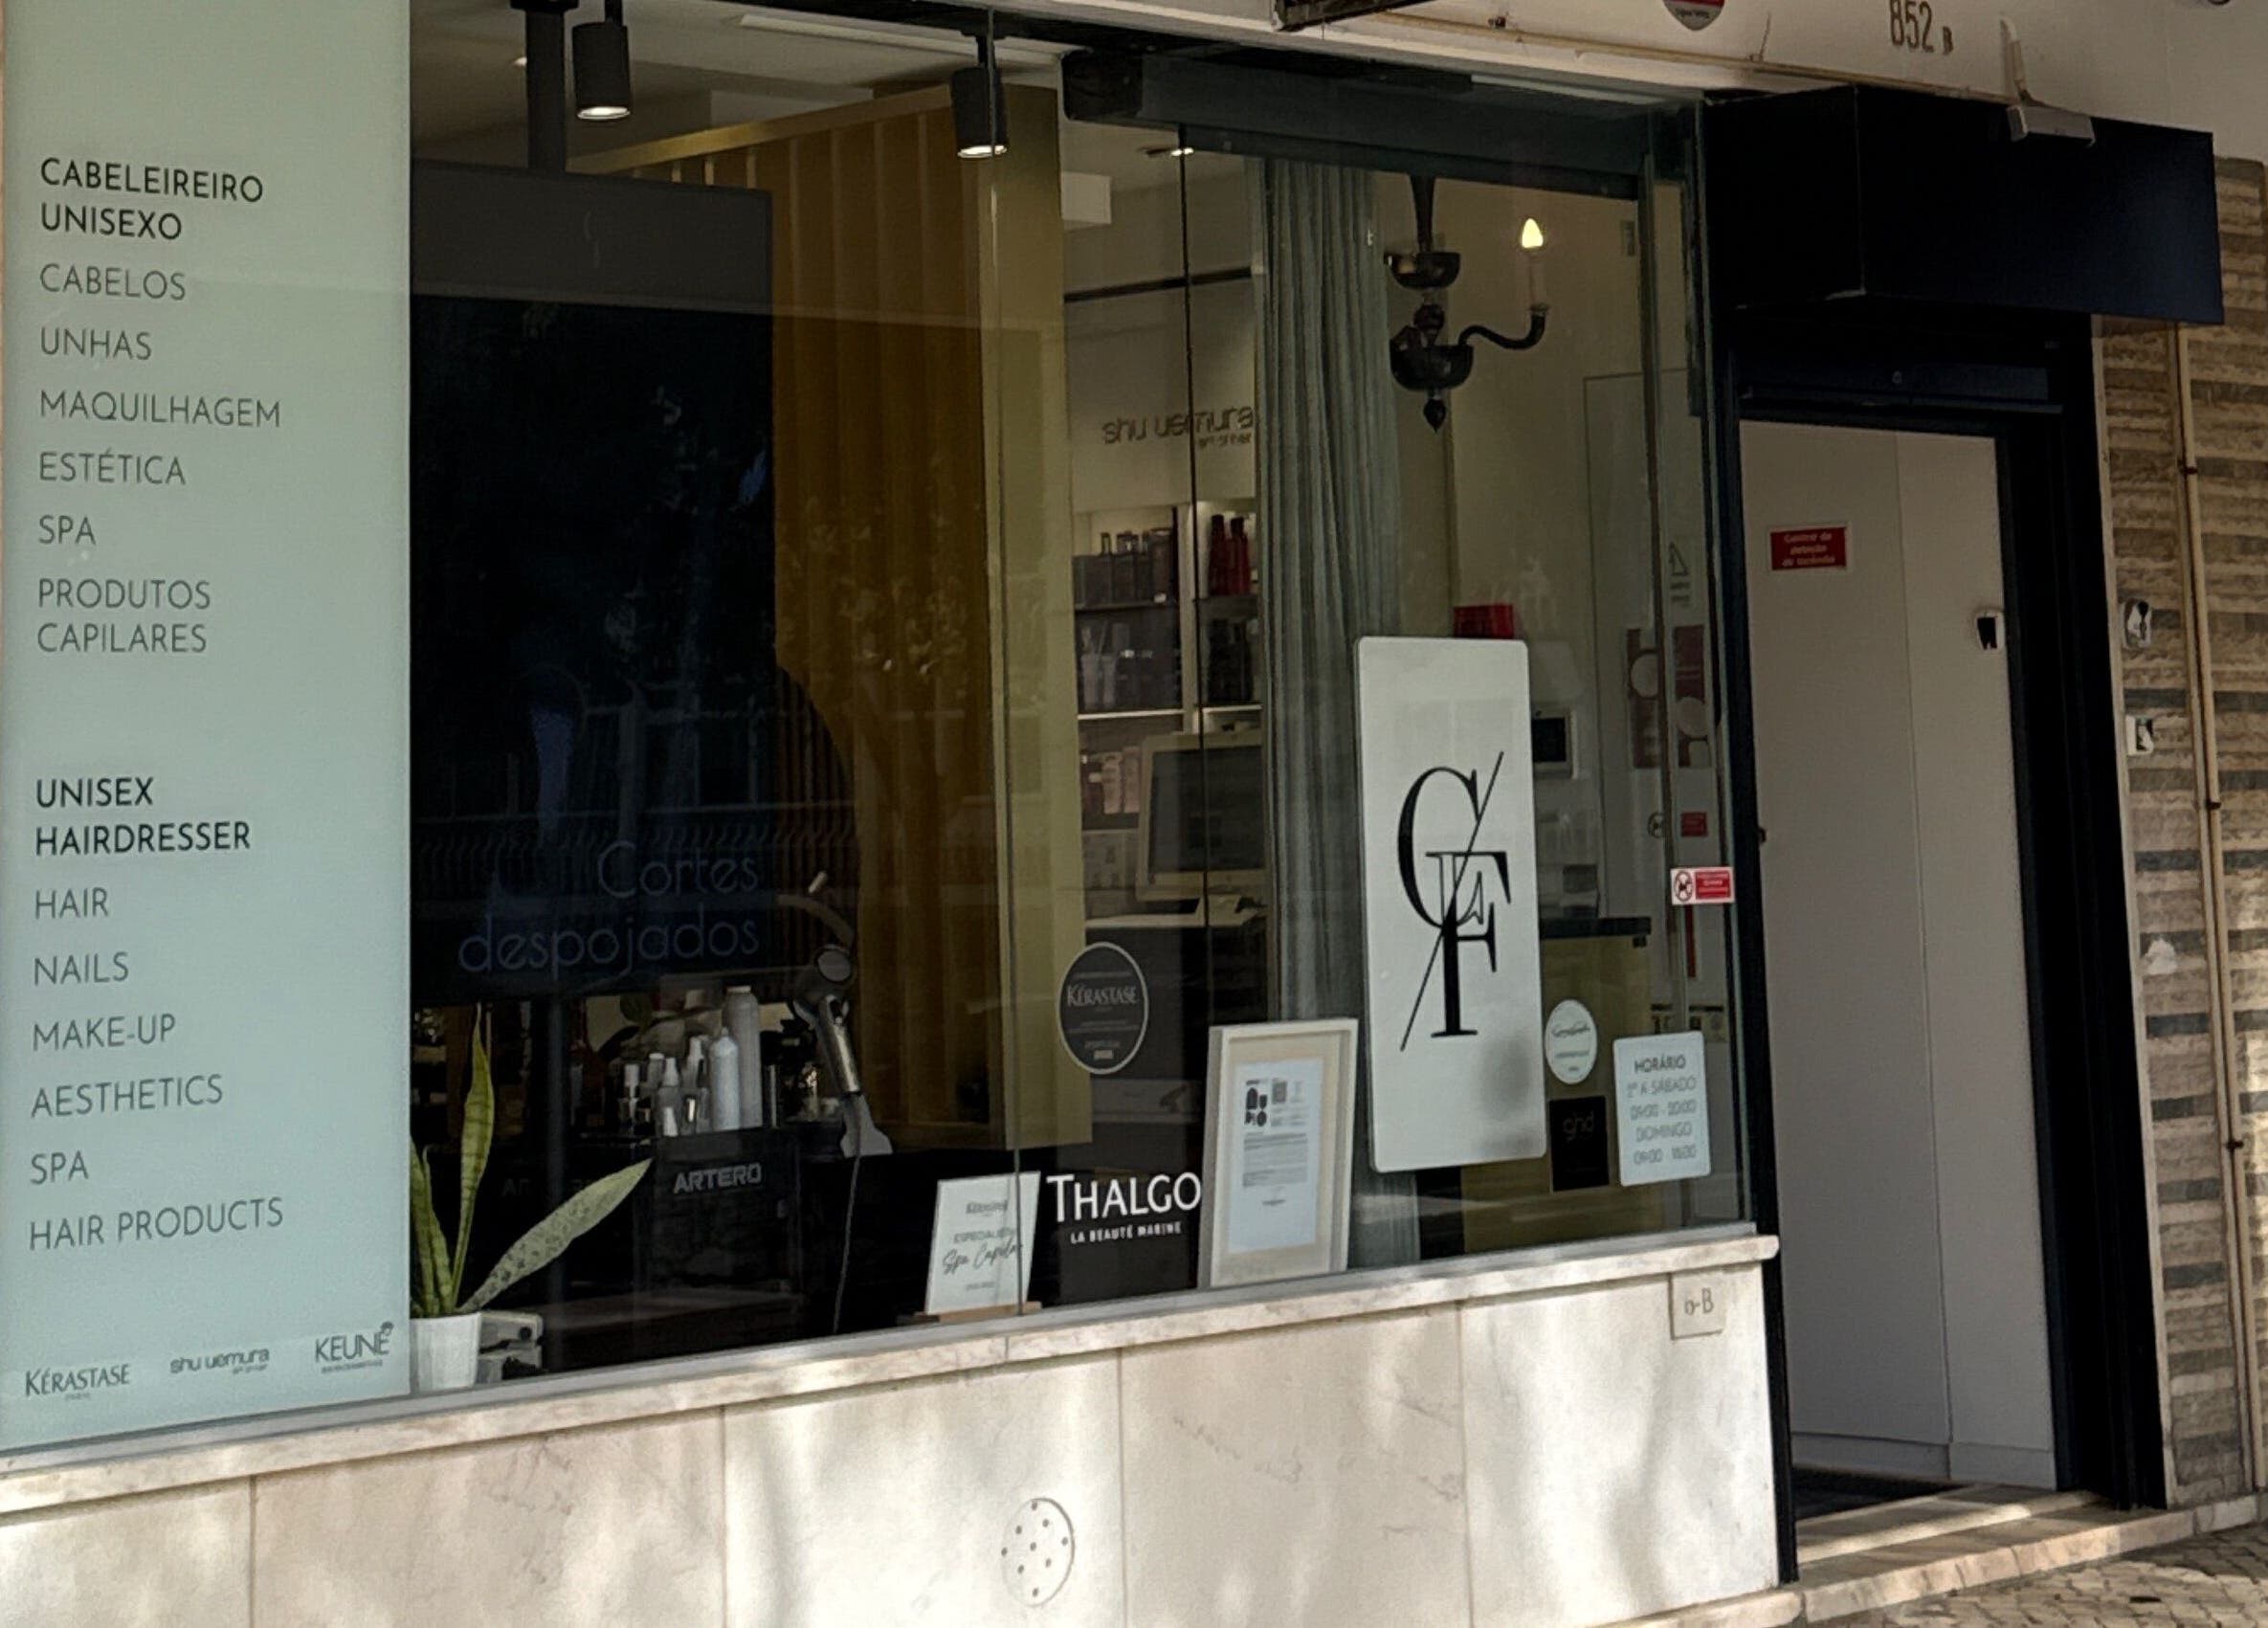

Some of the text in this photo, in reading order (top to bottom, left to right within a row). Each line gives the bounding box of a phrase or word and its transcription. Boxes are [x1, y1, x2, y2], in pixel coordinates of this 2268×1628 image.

[1889, 0, 1934, 53] 852
[41, 158, 263, 203] CABELEIREIRO
[41, 203, 182, 240] UNISEXO
[40, 263, 186, 301] CABELOS
[40, 327, 152, 360] UNHAS
[40, 390, 280, 428] MAQUILHAGEM
[39, 449, 187, 485] ESTÉTICA
[38, 515, 97, 546] SPA
[38, 578, 211, 611] PRODUTOS
[37, 622, 207, 653] CAPILARES
[36, 776, 154, 809] UNISEX
[35, 821, 251, 856] HAIRDRESSER
[597, 839, 759, 898] Cortes
[34, 887, 109, 920] HAIR
[457, 903, 760, 982] despojados
[33, 951, 129, 986] NAILS
[33, 1014, 176, 1051] MAKE-UP
[1634, 1053, 1686, 1074] HORÁRIO
[32, 1074, 223, 1118] AESTHETICS
[31, 1150, 89, 1186] SPA
[673, 1162, 763, 1194] ARTERO
[1046, 1171, 1201, 1223] THALGO
[30, 1197, 283, 1251] HAIR PRODUCTS
[1071, 1231, 1085, 1244] LA
[315, 1332, 390, 1363] KEUNE
[26, 1364, 130, 1396] KÉRASTASE
